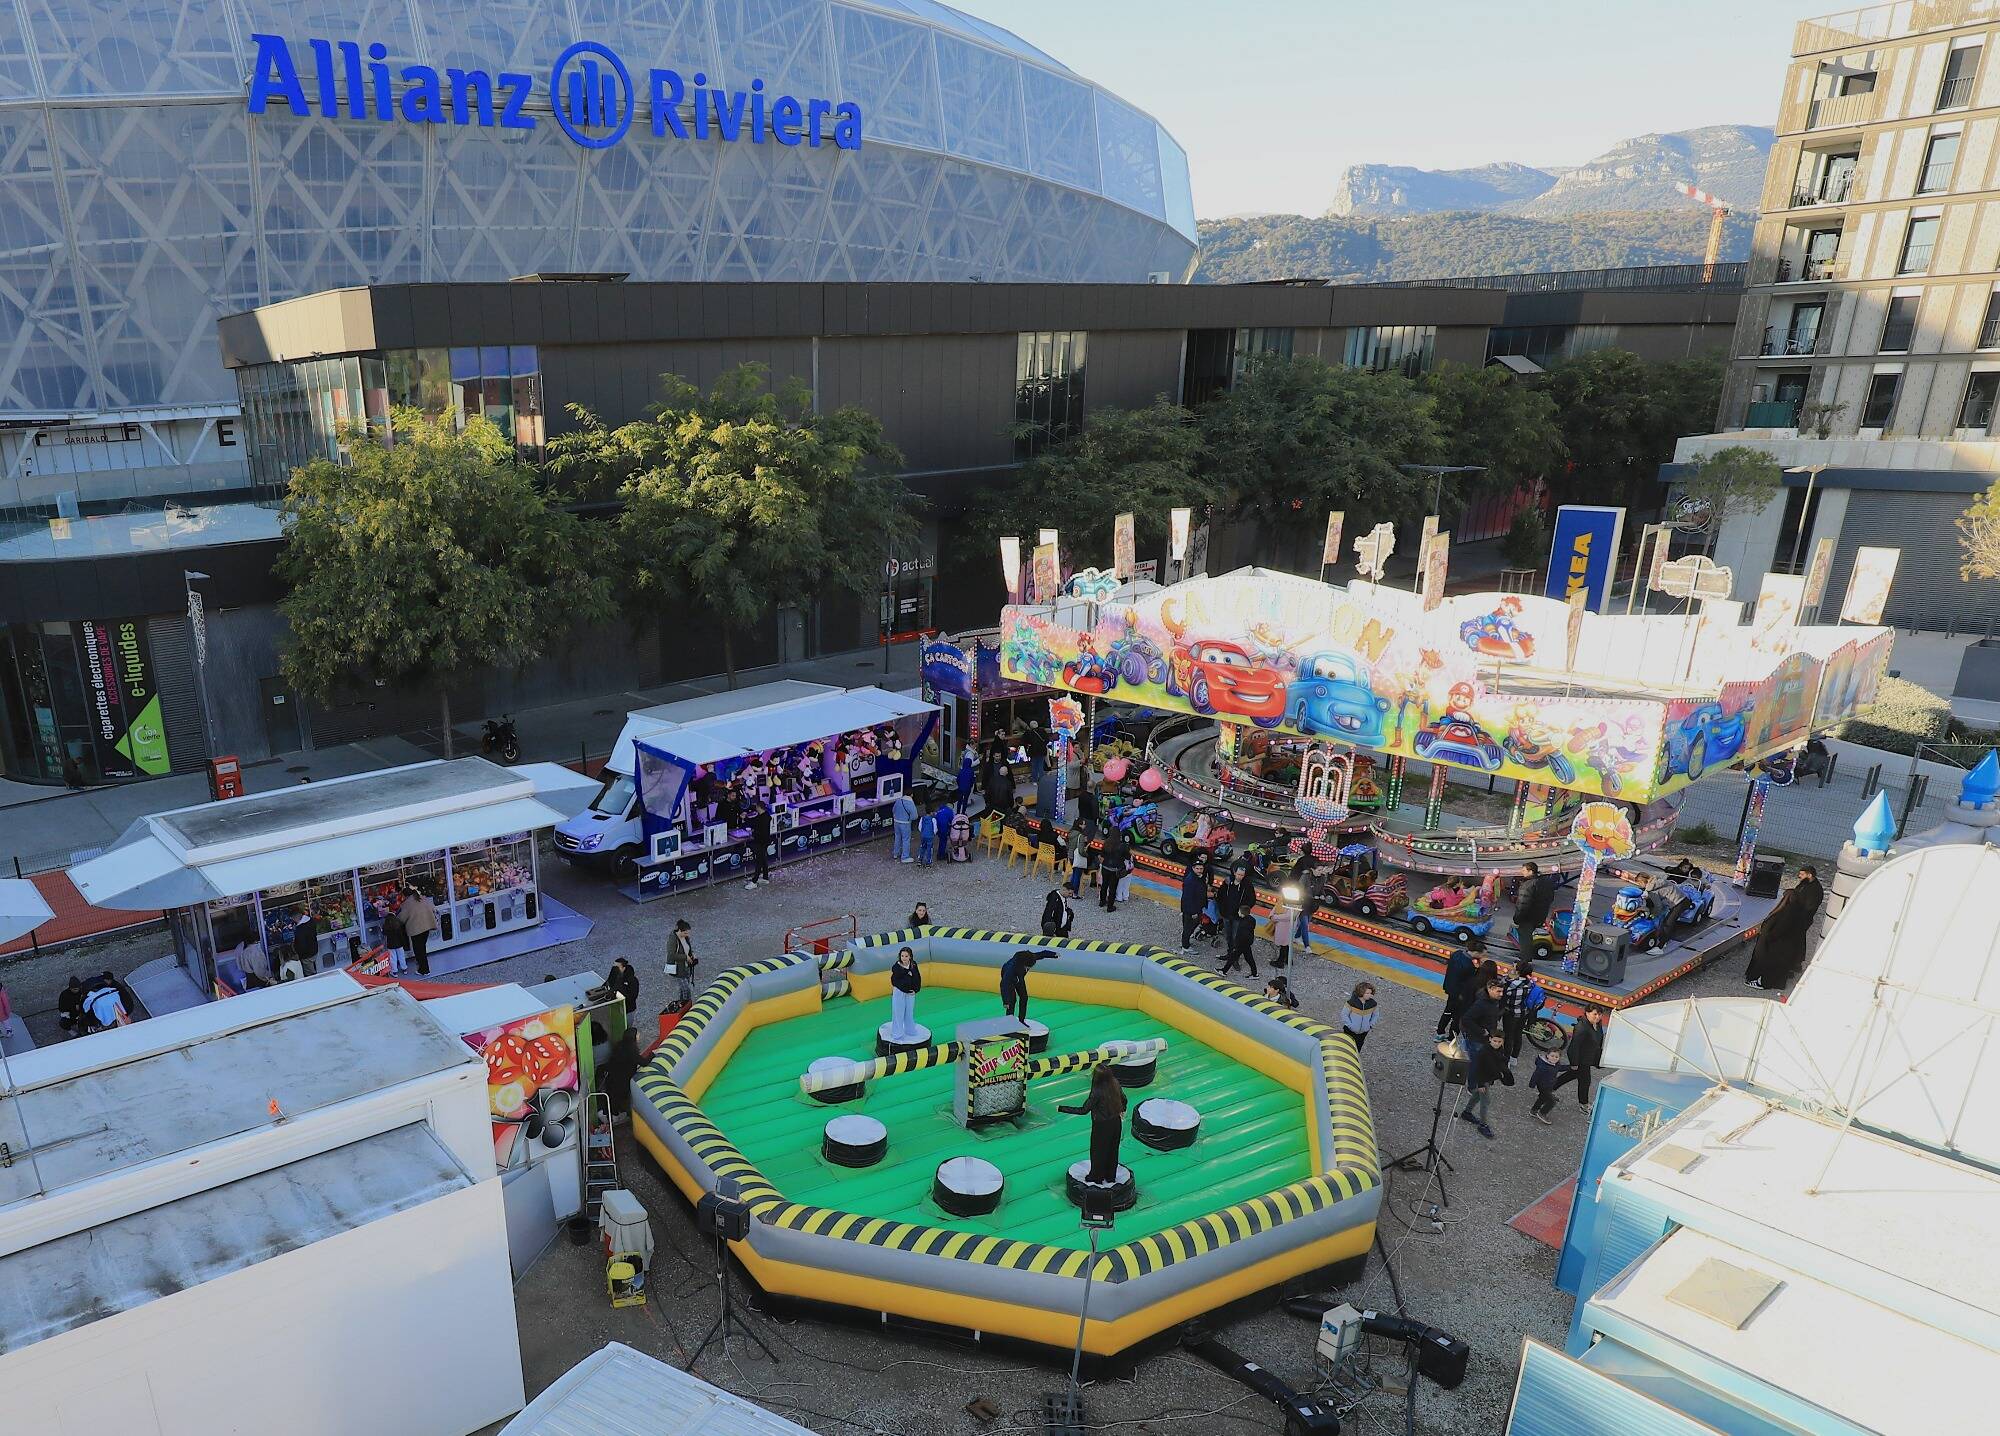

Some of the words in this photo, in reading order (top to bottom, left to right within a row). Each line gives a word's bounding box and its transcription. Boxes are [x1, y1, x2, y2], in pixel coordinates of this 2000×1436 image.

[248, 33, 536, 129] Allianz
[650, 68, 862, 150] Riviera
[902, 555, 934, 571] actual
[1135, 562, 1148, 570] VERT
[82, 621, 105, 689] électroniques
[117, 622, 146, 697] e-liquides
[102, 656, 119, 705] ACCESSOIRES
[95, 690, 115, 740] cigarettes
